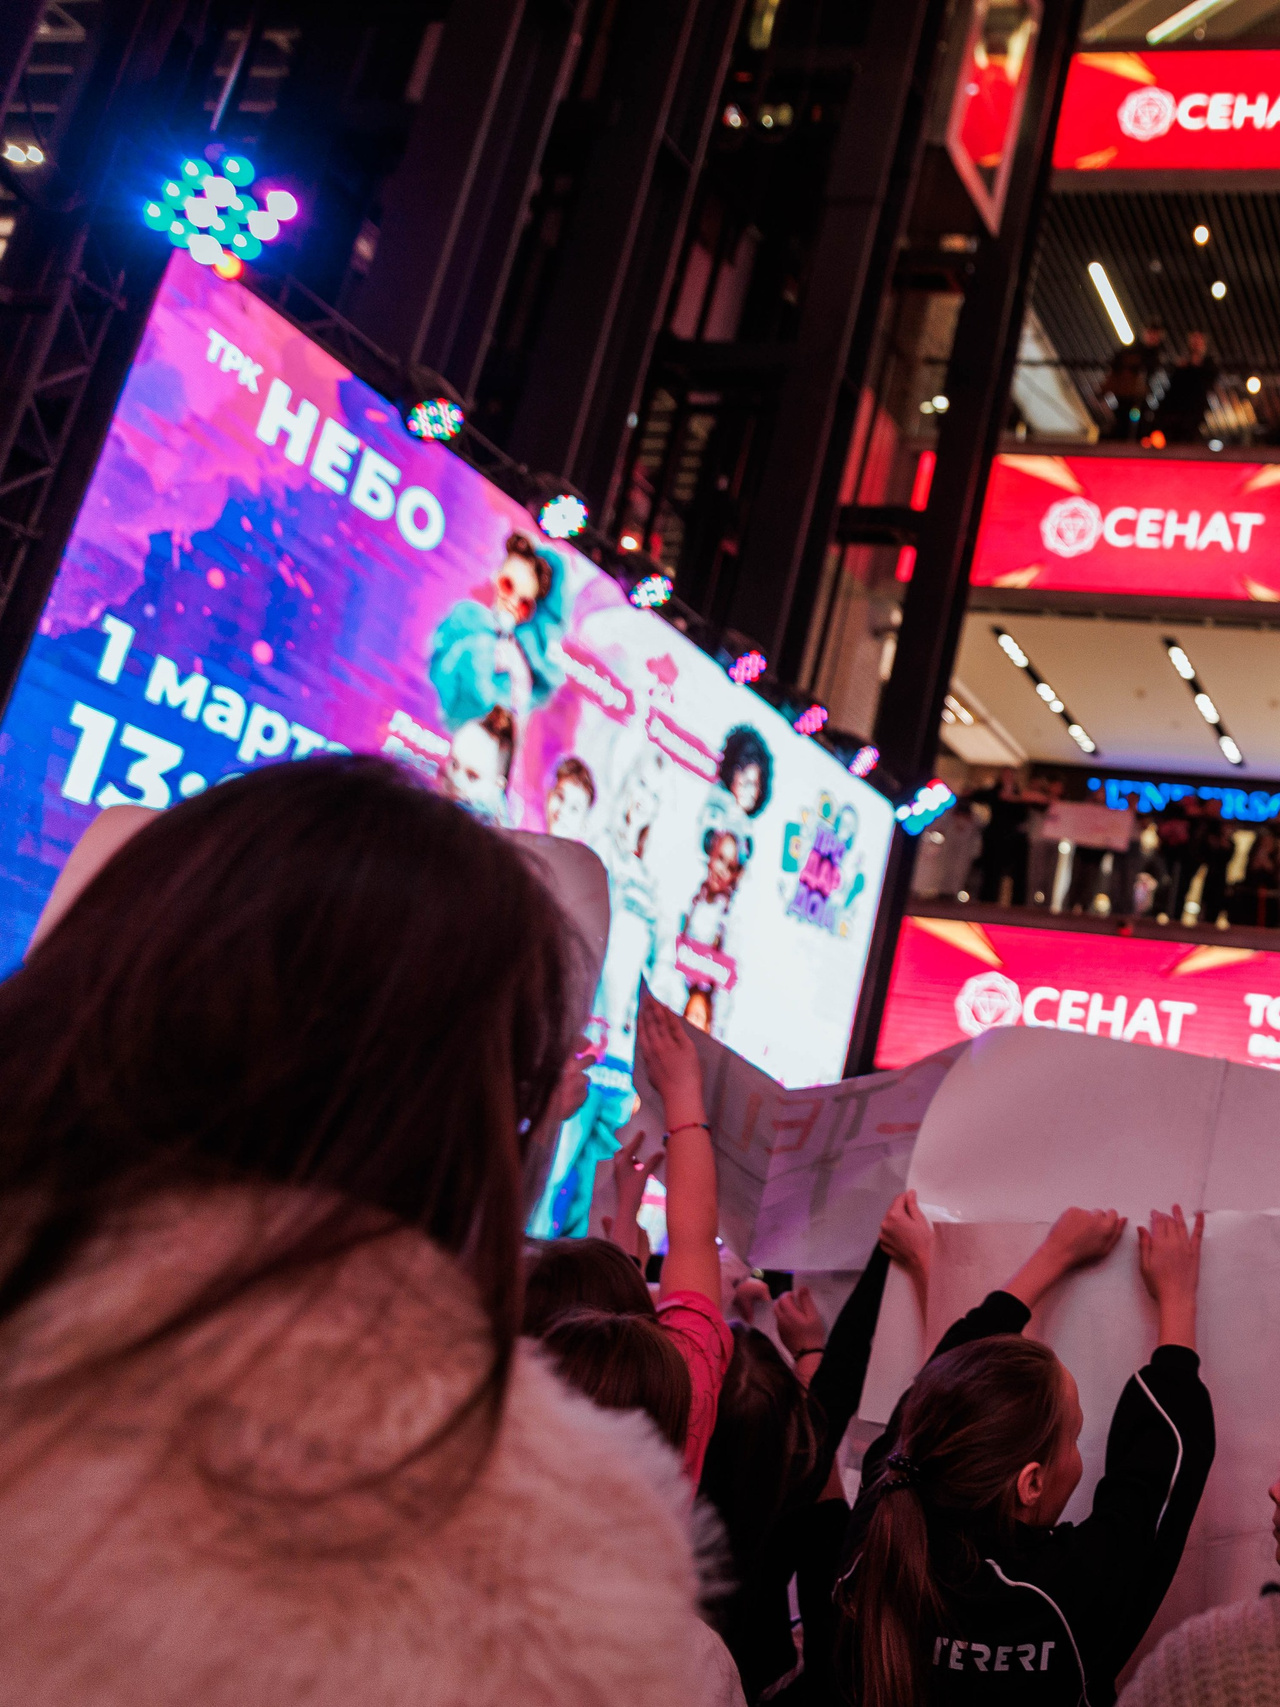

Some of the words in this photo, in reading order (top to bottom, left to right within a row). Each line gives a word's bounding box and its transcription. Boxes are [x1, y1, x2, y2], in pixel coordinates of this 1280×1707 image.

[206, 328, 264, 394] ТРК
[255, 377, 446, 551] НЕБО
[1103, 506, 1265, 553] СЕНАТ
[97, 614, 135, 684] 1
[144, 653, 353, 763] март
[1022, 985, 1198, 1047] СЕНАТ
